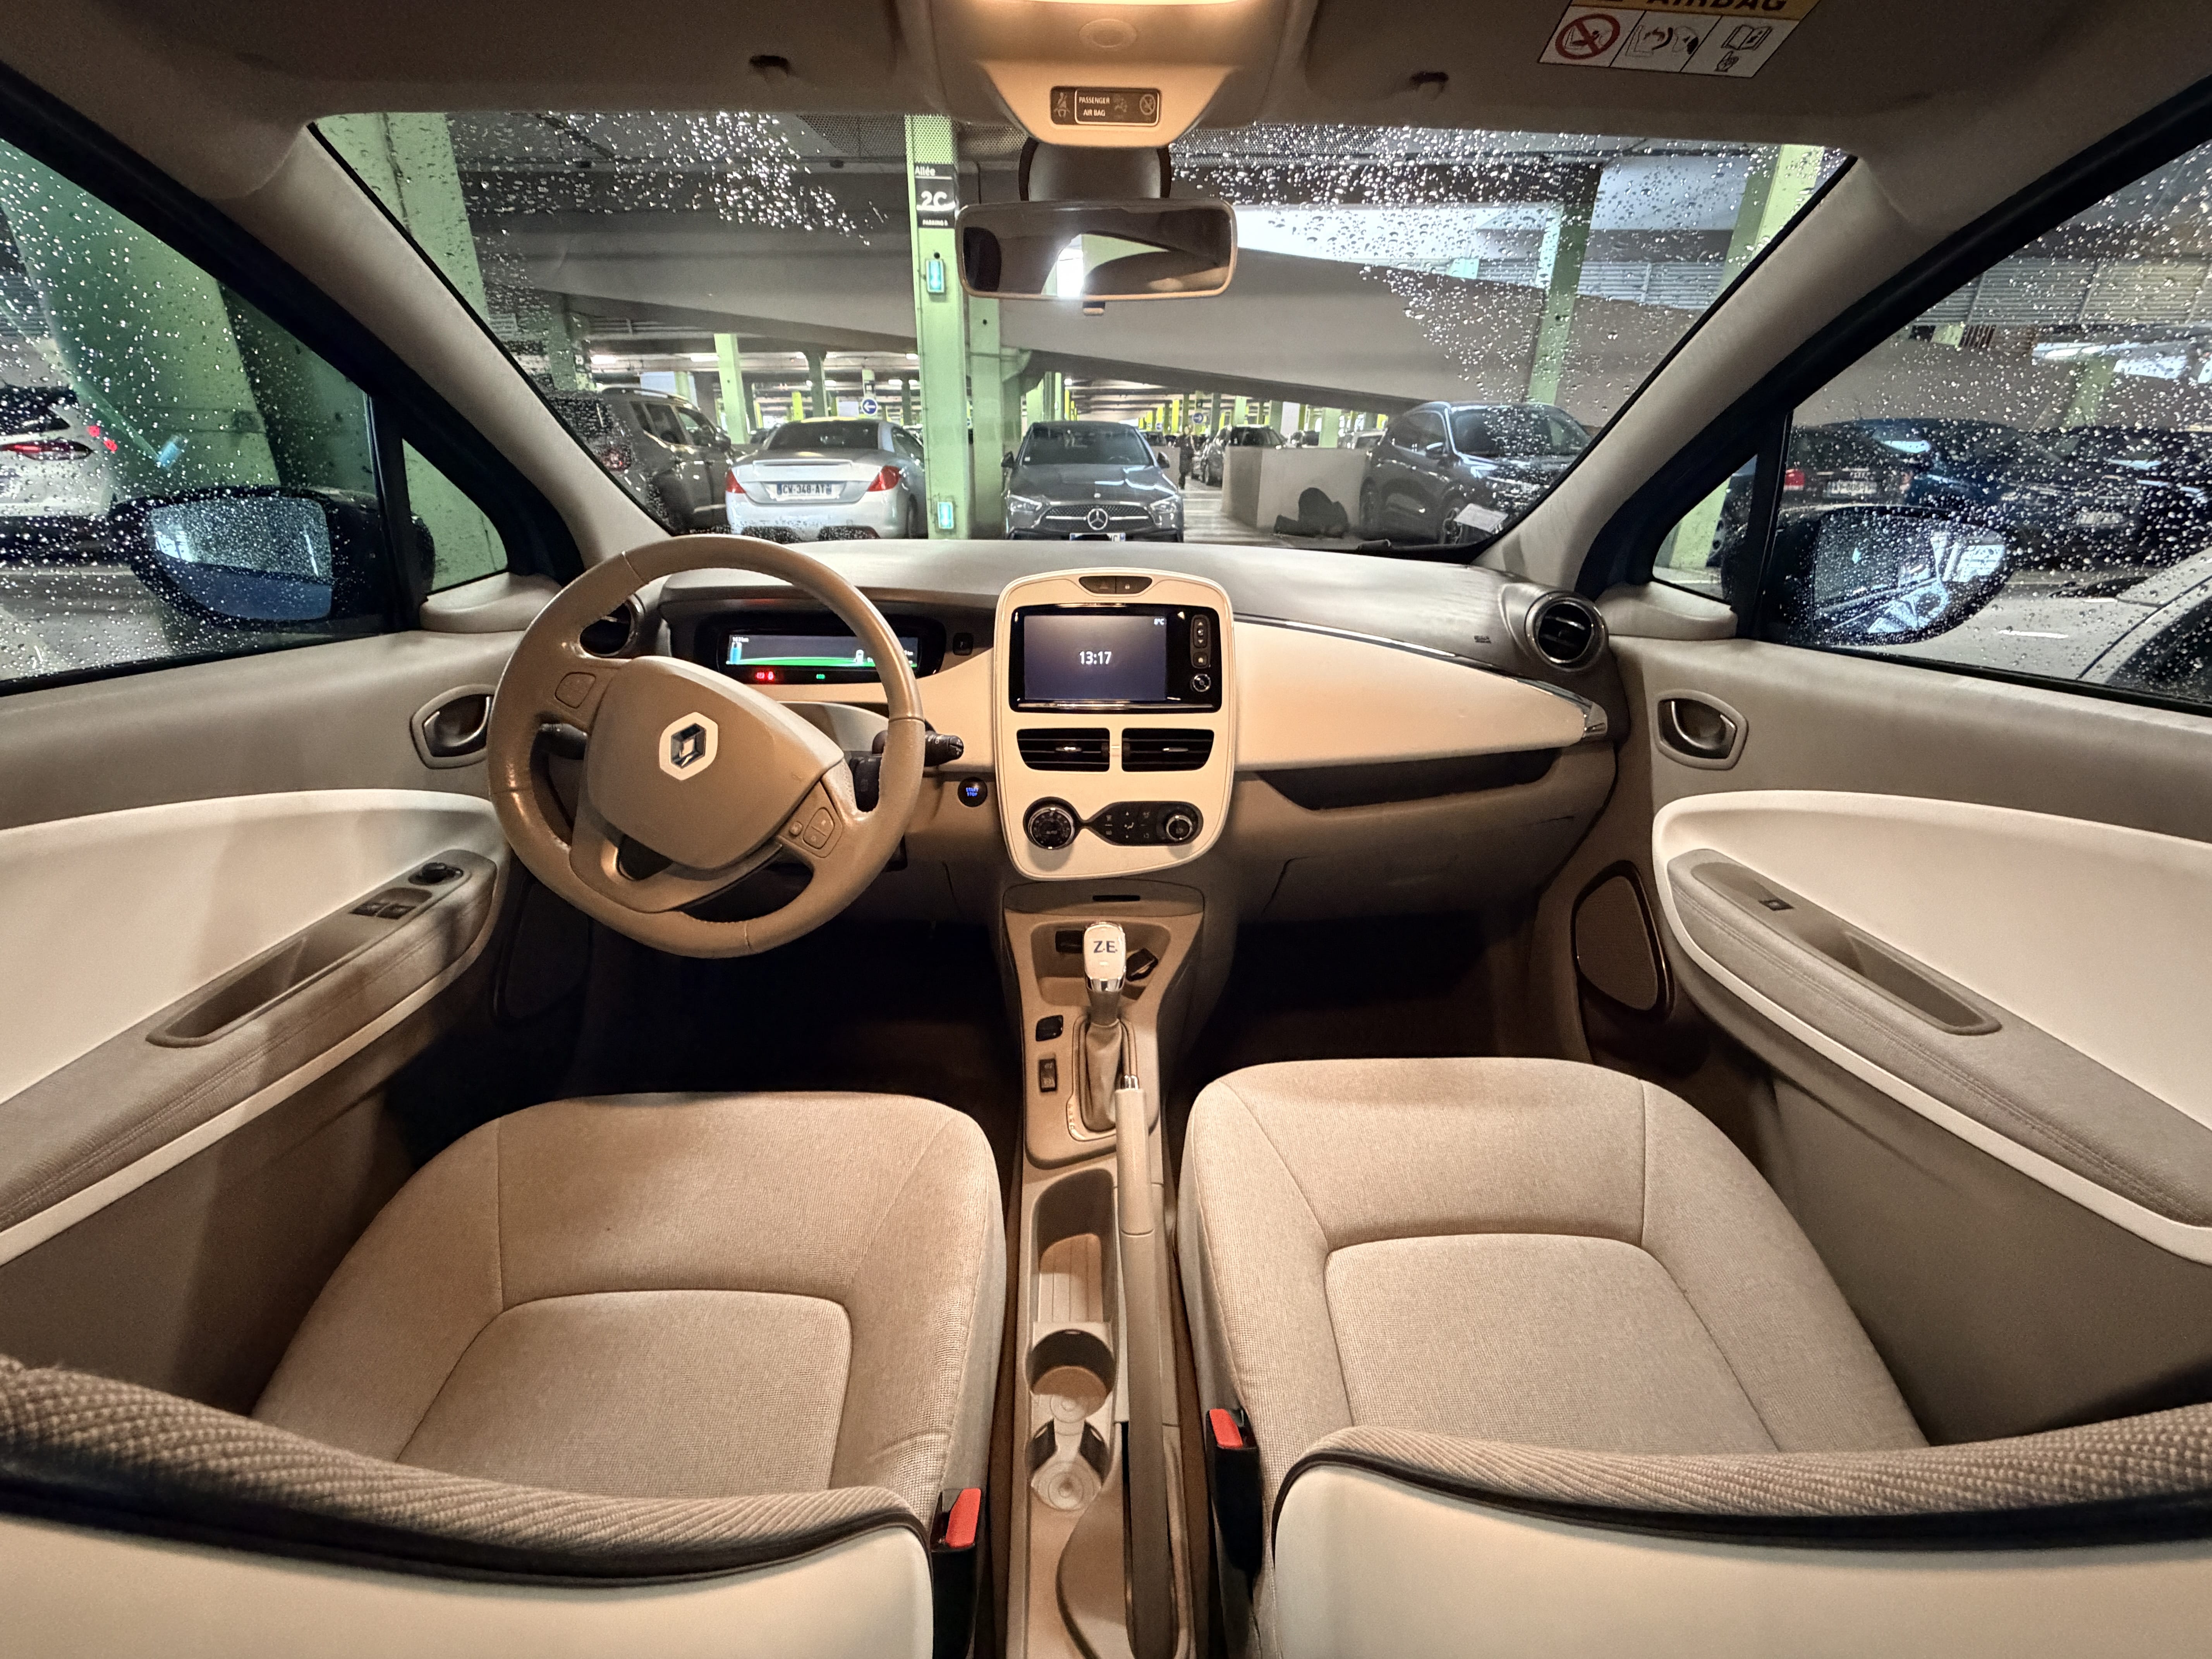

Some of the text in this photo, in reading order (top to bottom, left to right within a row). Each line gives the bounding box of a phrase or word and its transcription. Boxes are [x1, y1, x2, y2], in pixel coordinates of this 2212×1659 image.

[915, 166, 936, 176] Allée
[921, 191, 947, 209] 2C
[1079, 651, 1112, 665] 13:17
